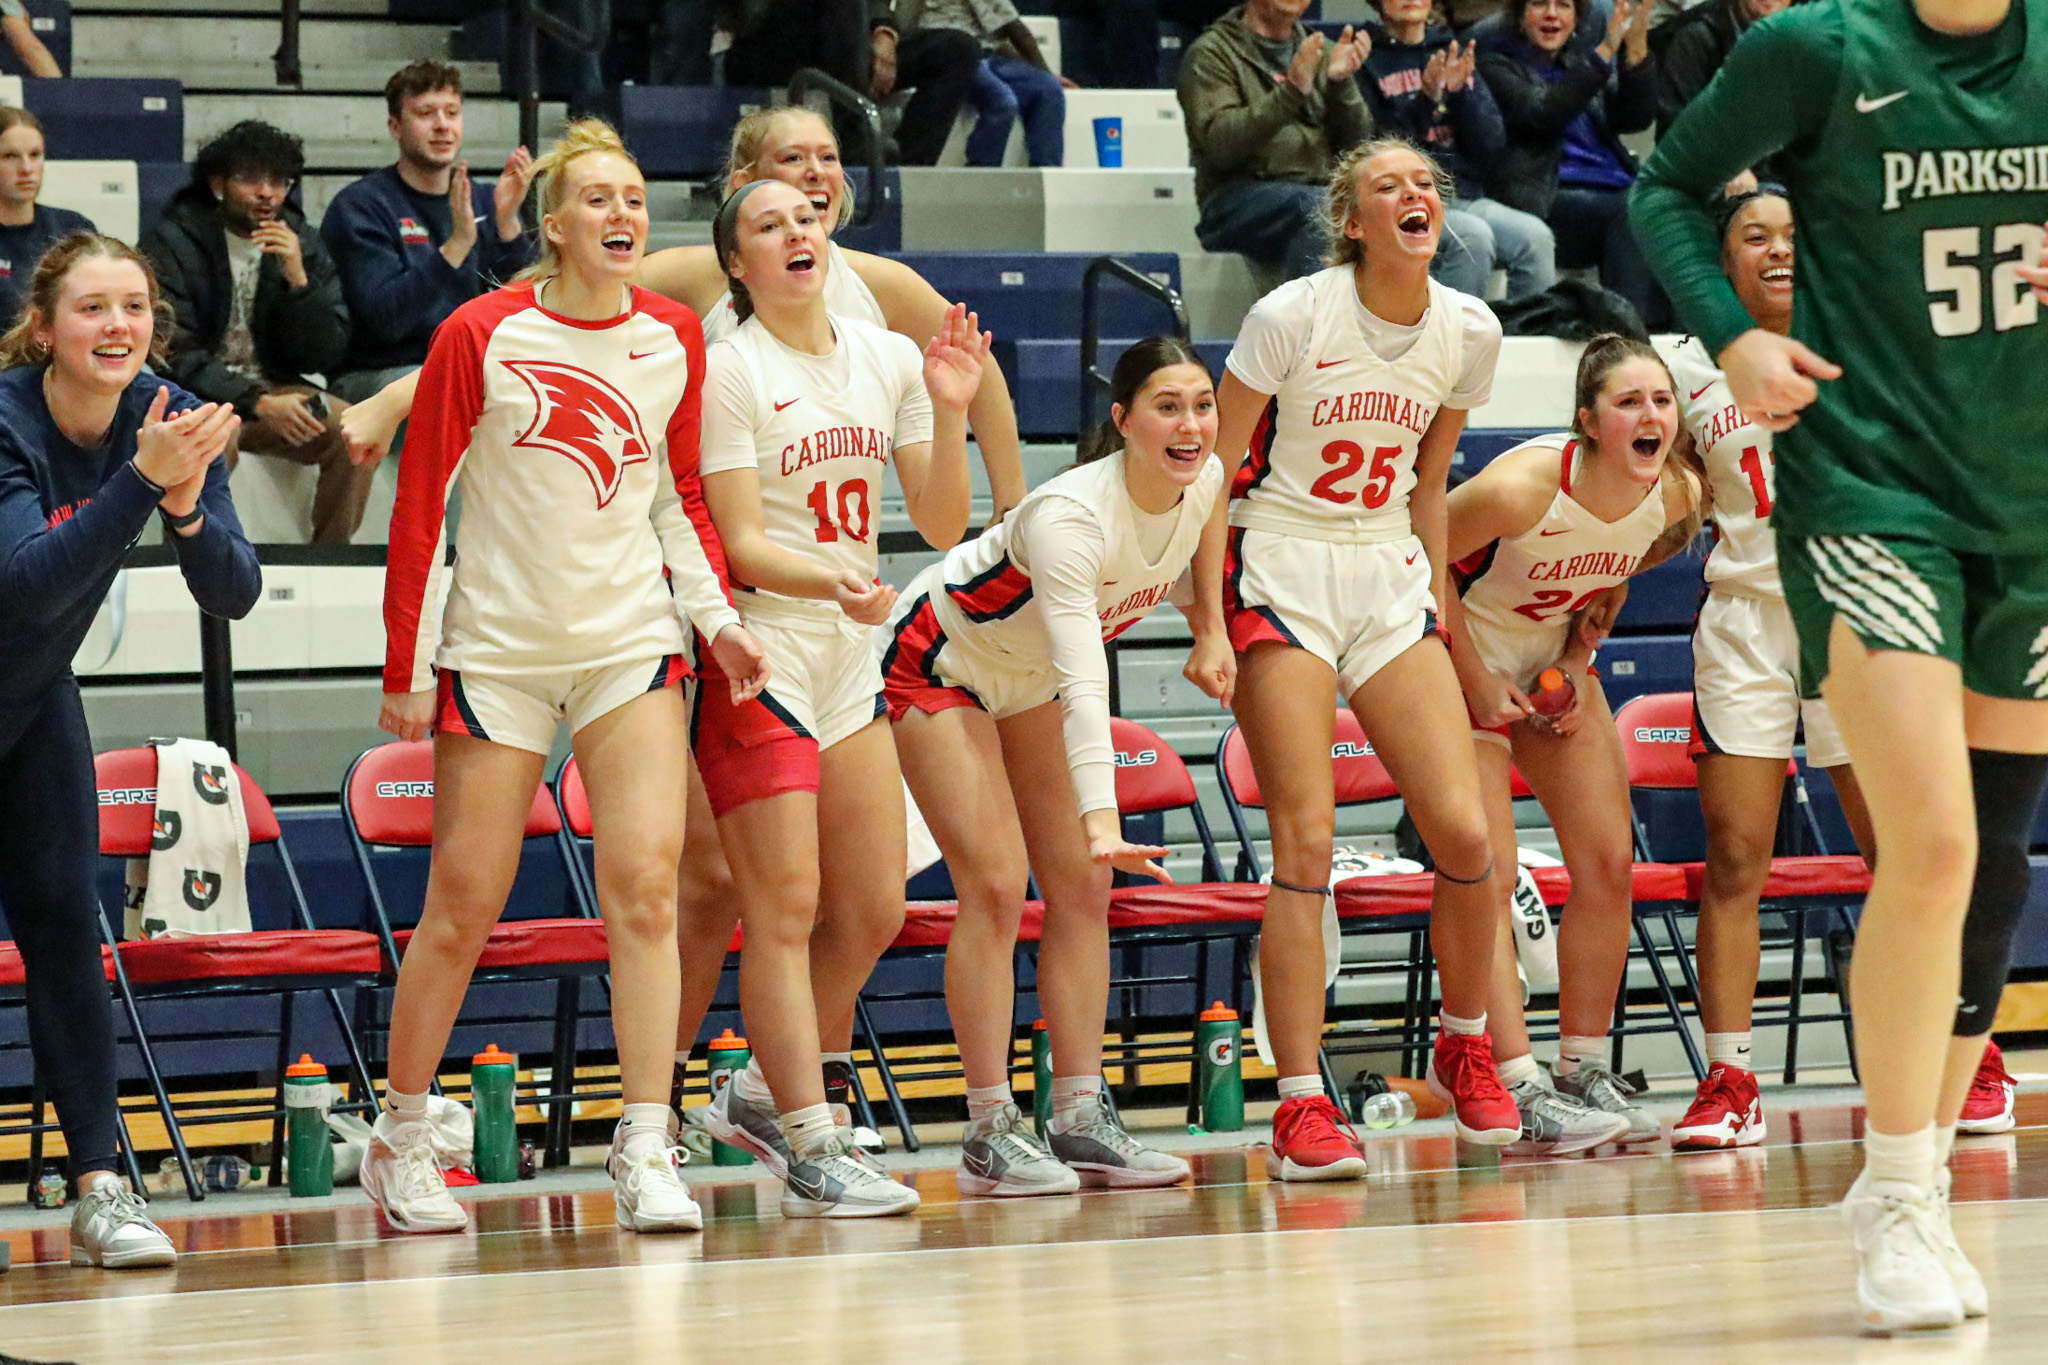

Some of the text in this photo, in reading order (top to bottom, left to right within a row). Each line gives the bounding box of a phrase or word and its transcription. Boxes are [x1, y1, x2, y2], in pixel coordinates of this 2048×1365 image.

[1922, 222, 2046, 337] 52
[1312, 391, 1430, 436] CARDINALS
[1309, 439, 1403, 510] 25
[1739, 445, 1775, 519] 1
[807, 477, 871, 544] 10
[1097, 580, 1175, 620] ARDINA
[1209, 1037, 1233, 1066] G
